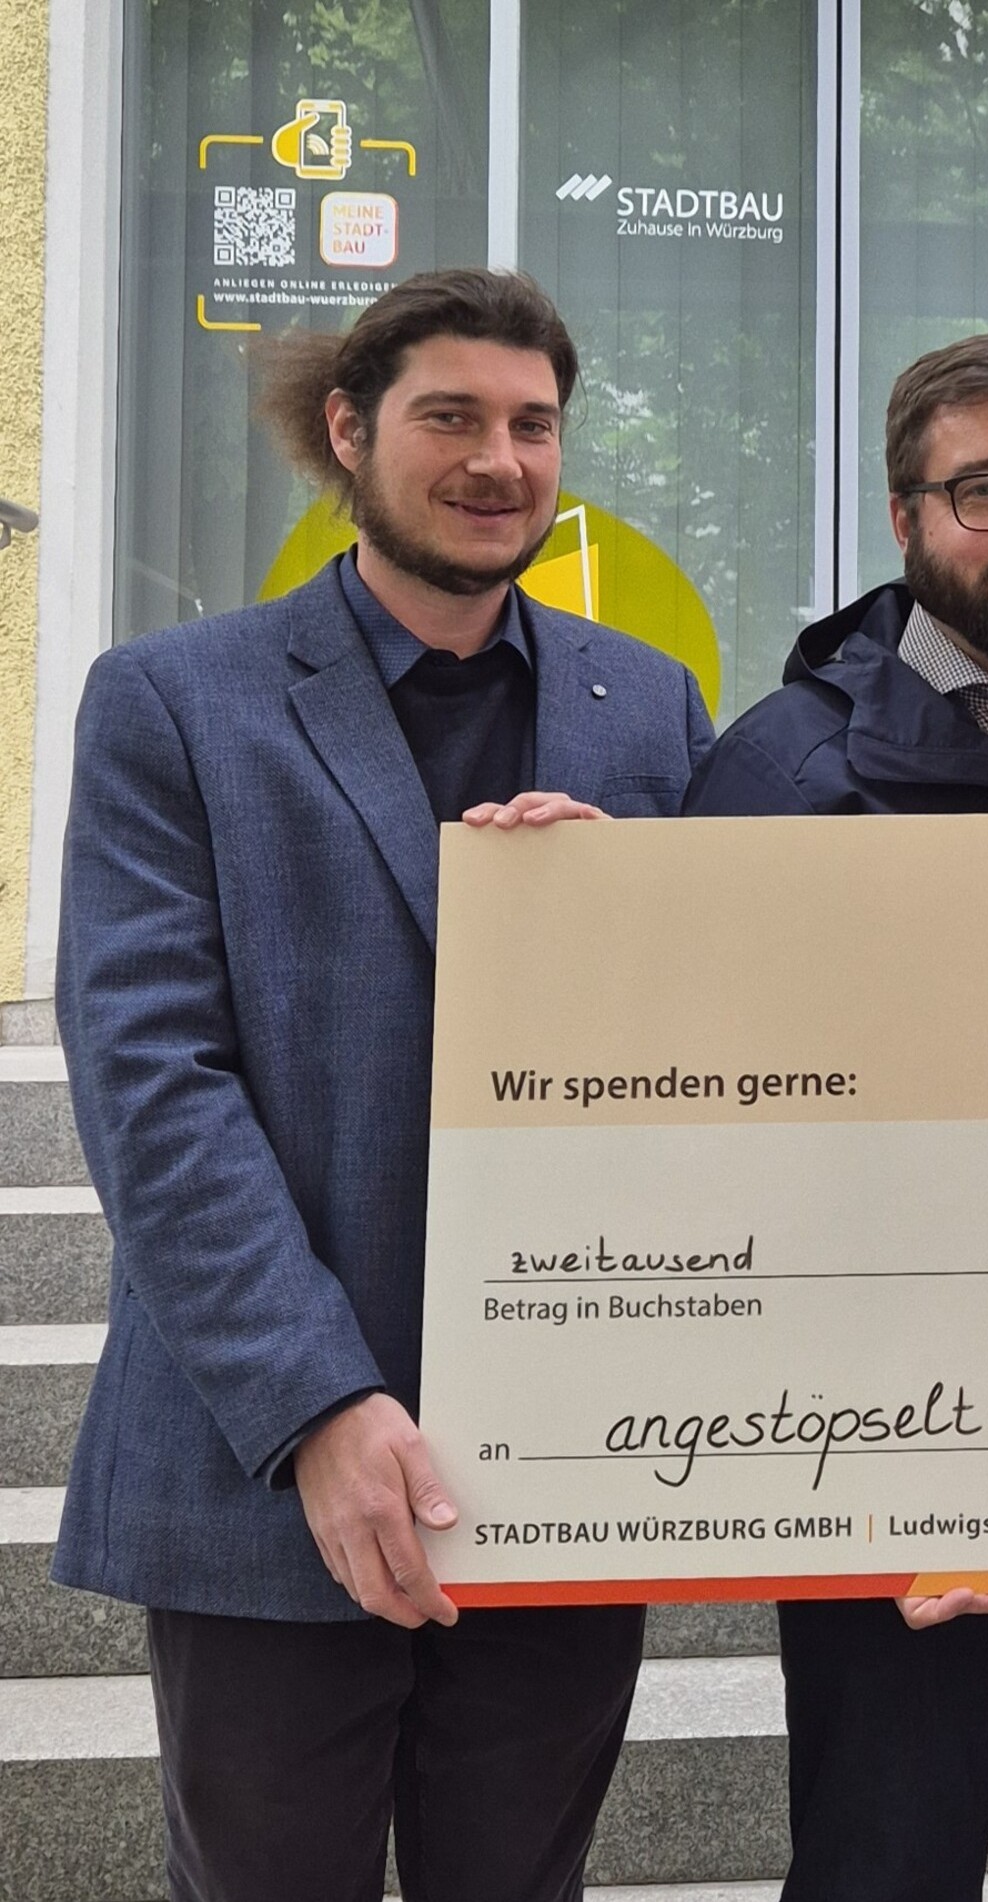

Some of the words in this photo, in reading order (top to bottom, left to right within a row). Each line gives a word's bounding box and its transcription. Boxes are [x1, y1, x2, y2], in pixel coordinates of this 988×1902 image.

[333, 205, 383, 218] MEINE
[617, 187, 783, 221] STADTBAU
[333, 223, 389, 237] STADT-
[617, 219, 683, 236] Zuhause
[688, 221, 701, 236] in
[706, 222, 783, 243] Würzburg
[333, 241, 366, 254] BAU
[214, 278, 275, 288] ANLIEGEN
[281, 279, 326, 290] ONLINE
[491, 1070, 553, 1101] Wir
[564, 1067, 724, 1108] spenden
[737, 1073, 856, 1105] gerne:
[512, 1235, 753, 1273] zweitausend
[485, 1298, 567, 1325] Betrag
[577, 1296, 599, 1319] in
[609, 1293, 762, 1318] Buchstaben
[605, 1381, 982, 1491] angestöpselt
[479, 1443, 509, 1460] an
[475, 1522, 608, 1545] STADTBAU
[617, 1516, 765, 1542] WÜRZBURG
[774, 1516, 851, 1539] GMBH
